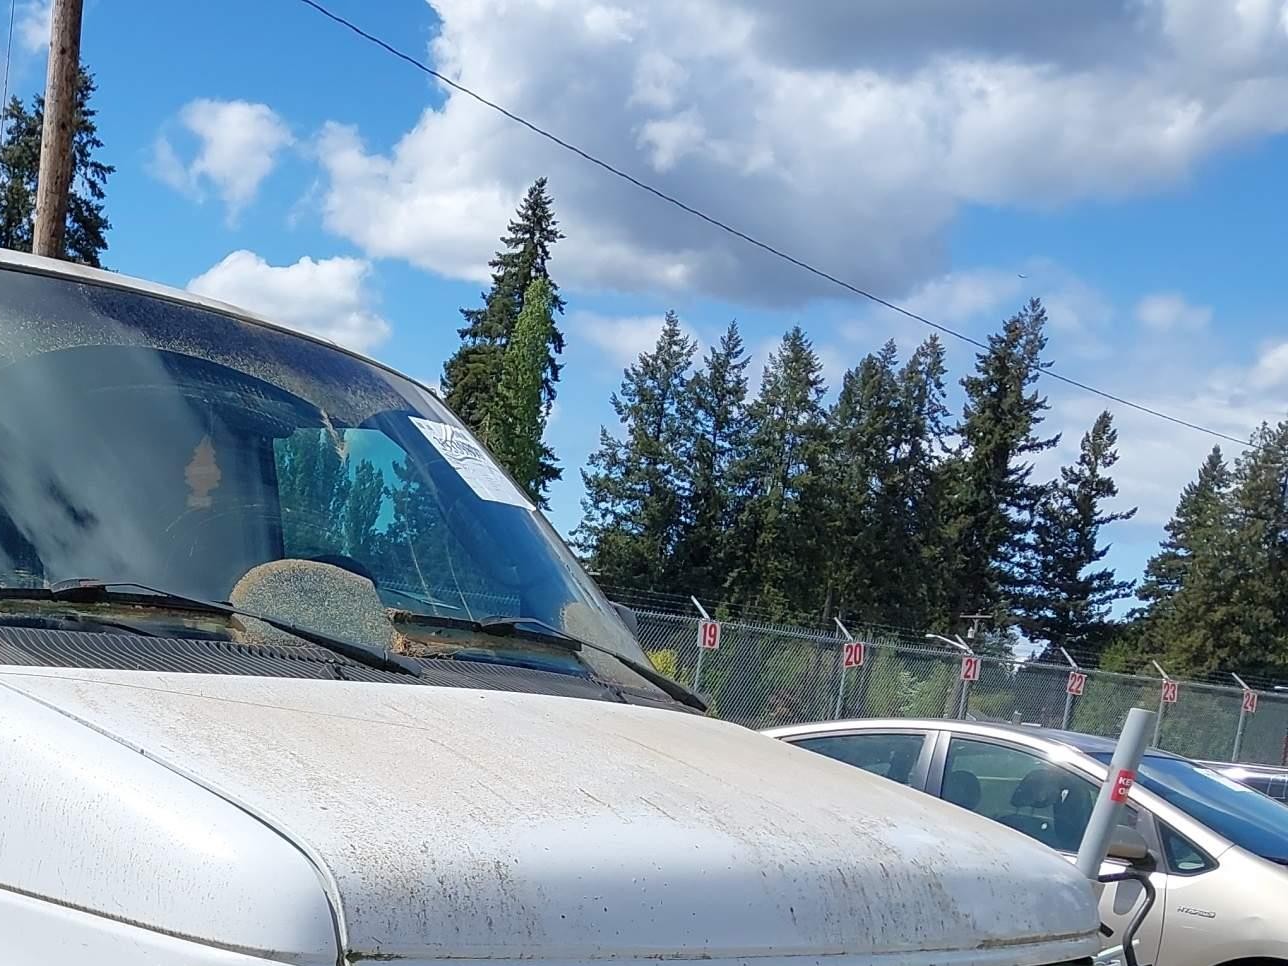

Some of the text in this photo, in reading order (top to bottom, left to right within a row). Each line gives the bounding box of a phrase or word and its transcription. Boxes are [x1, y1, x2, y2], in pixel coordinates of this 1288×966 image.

[701, 623, 718, 647] 19
[844, 643, 863, 666] 20
[963, 659, 978, 679] 21
[1068, 672, 1085, 694] 22
[1163, 682, 1177, 700] 23
[1244, 692, 1257, 711] 24
